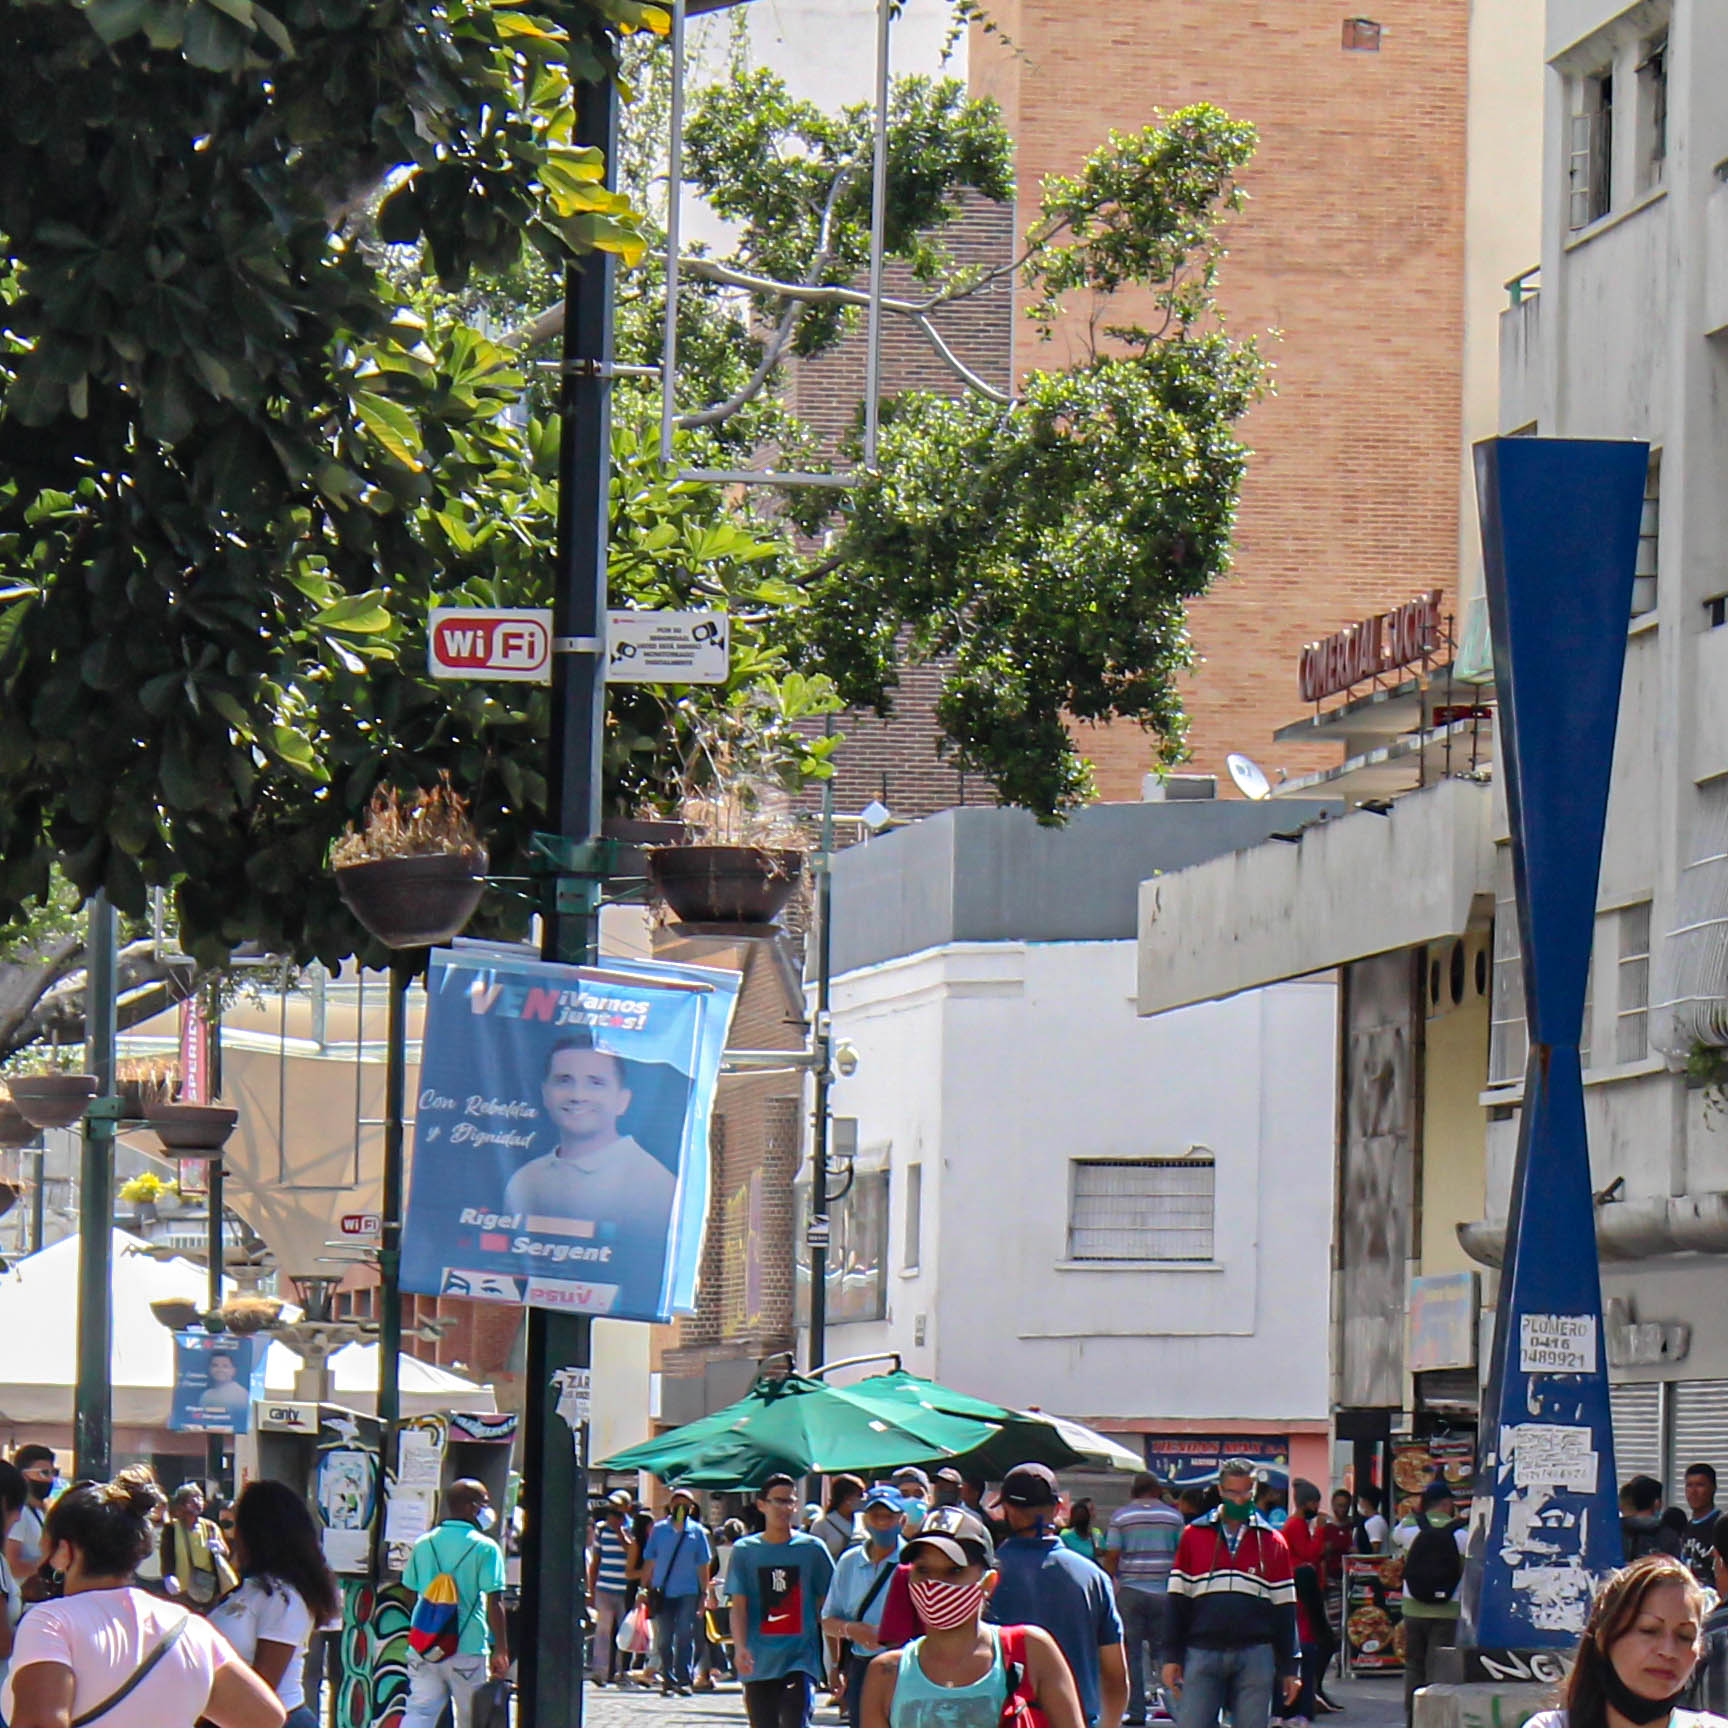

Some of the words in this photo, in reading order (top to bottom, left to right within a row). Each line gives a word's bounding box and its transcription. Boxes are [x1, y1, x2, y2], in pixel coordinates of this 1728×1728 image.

[443, 630, 536, 659] WiFi
[471, 980, 563, 1022] VEN
[418, 1088, 456, 1112] Con
[449, 1121, 537, 1151] Dignidad
[459, 1207, 521, 1230] Rigel
[511, 1237, 612, 1263] Sergent
